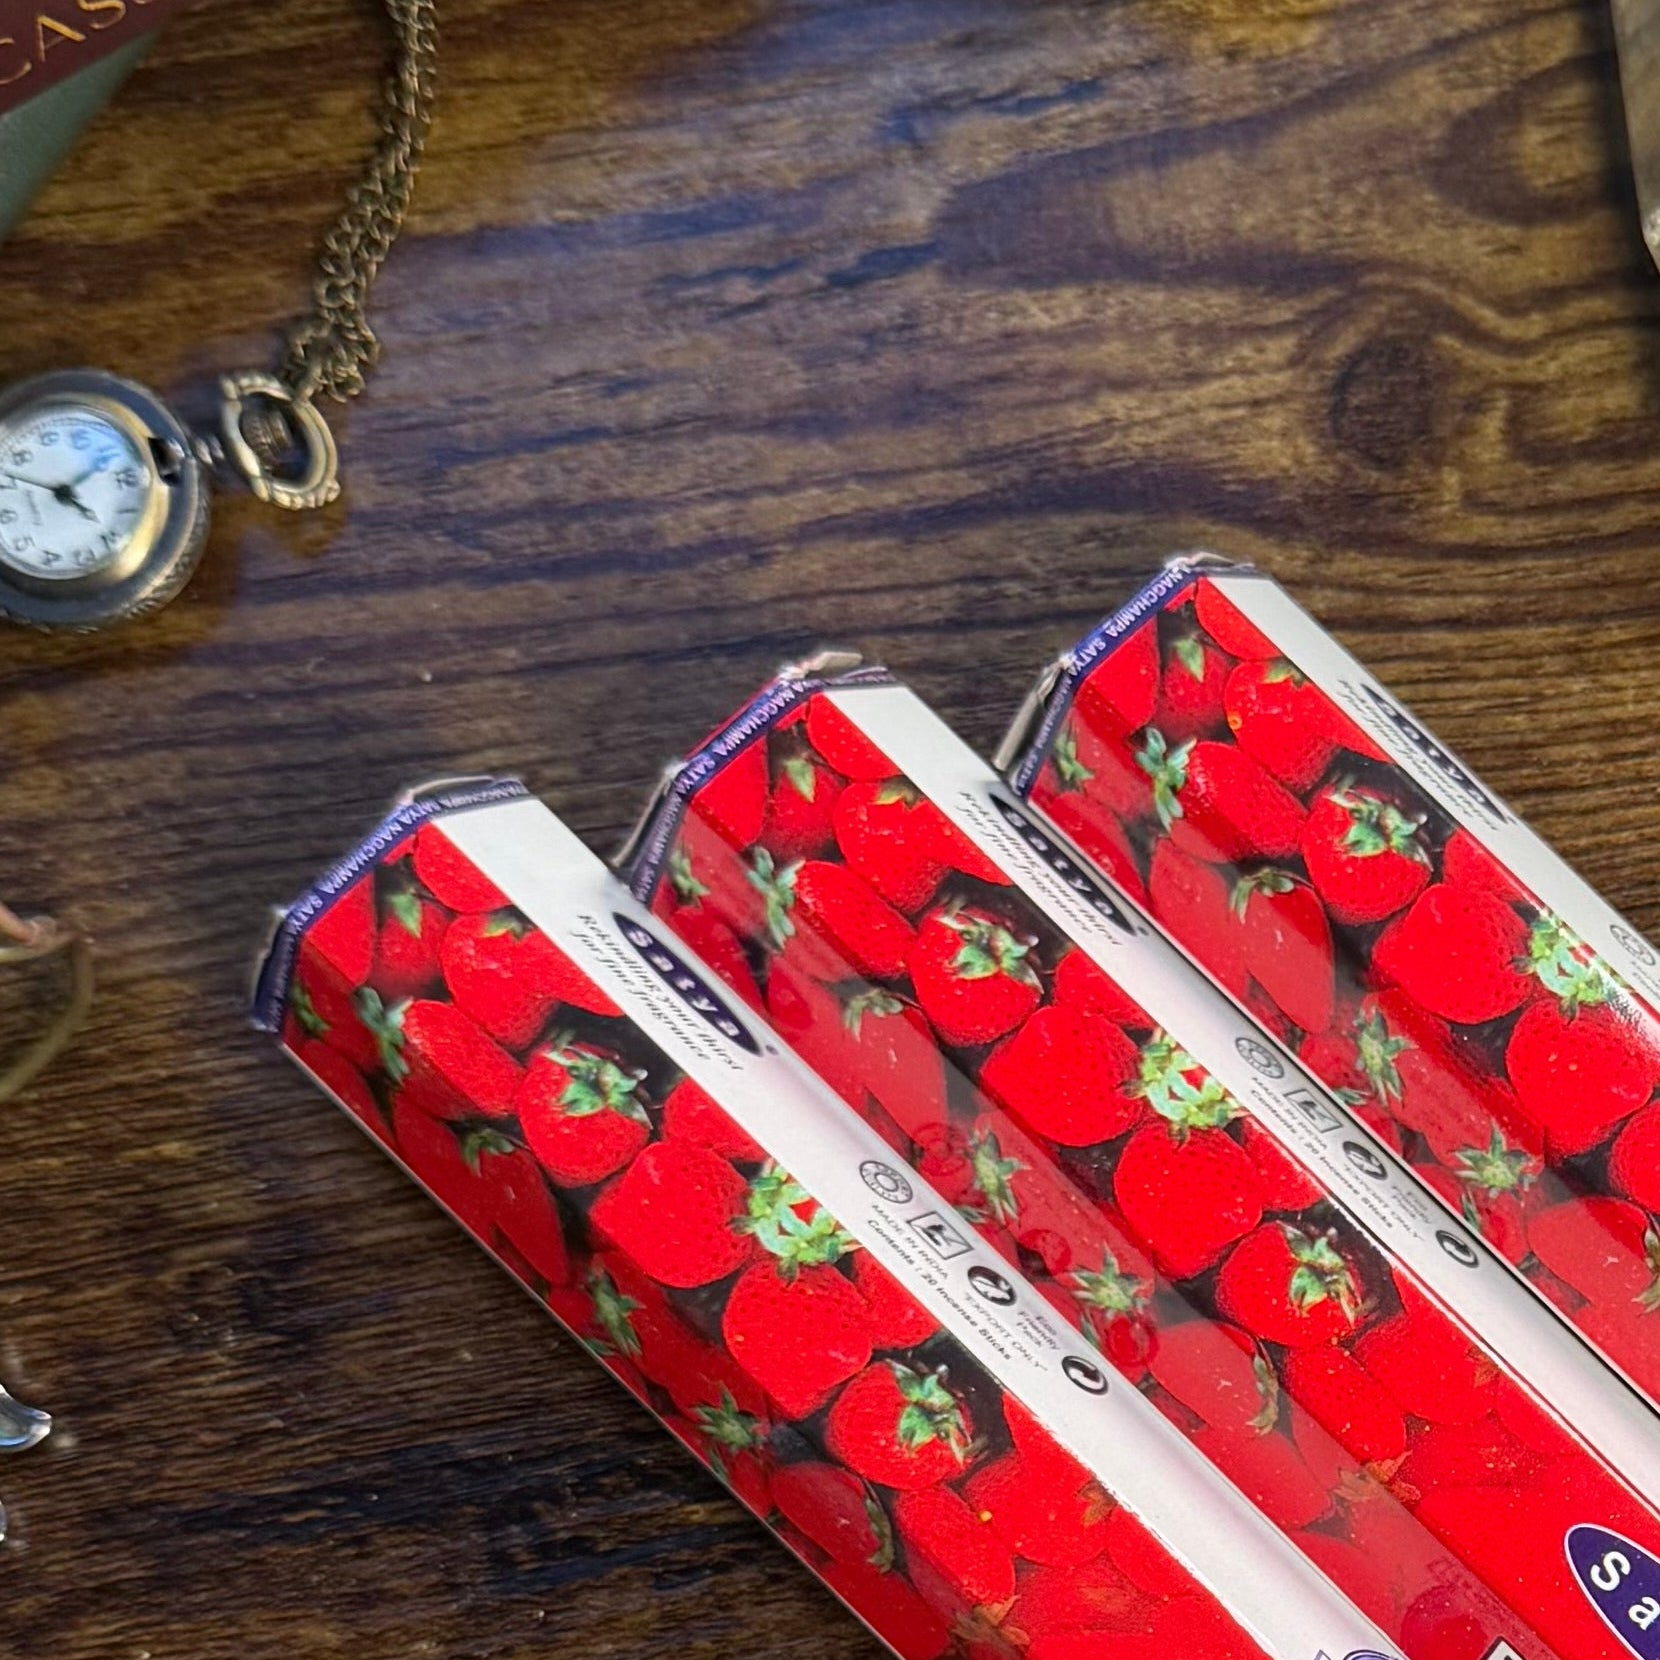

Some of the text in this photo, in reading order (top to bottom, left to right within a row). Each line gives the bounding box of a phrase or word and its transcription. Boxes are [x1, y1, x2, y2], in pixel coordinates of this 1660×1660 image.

[1104, 567, 1184, 638] NAGCHAMPA
[319, 819, 403, 895] NAGCHAMPA
[1002, 806, 1117, 921] Satya
[569, 930, 709, 1059] for fine fragrance
[577, 914, 743, 1070] Rekindling your thirst
[627, 927, 740, 1038] Satya
